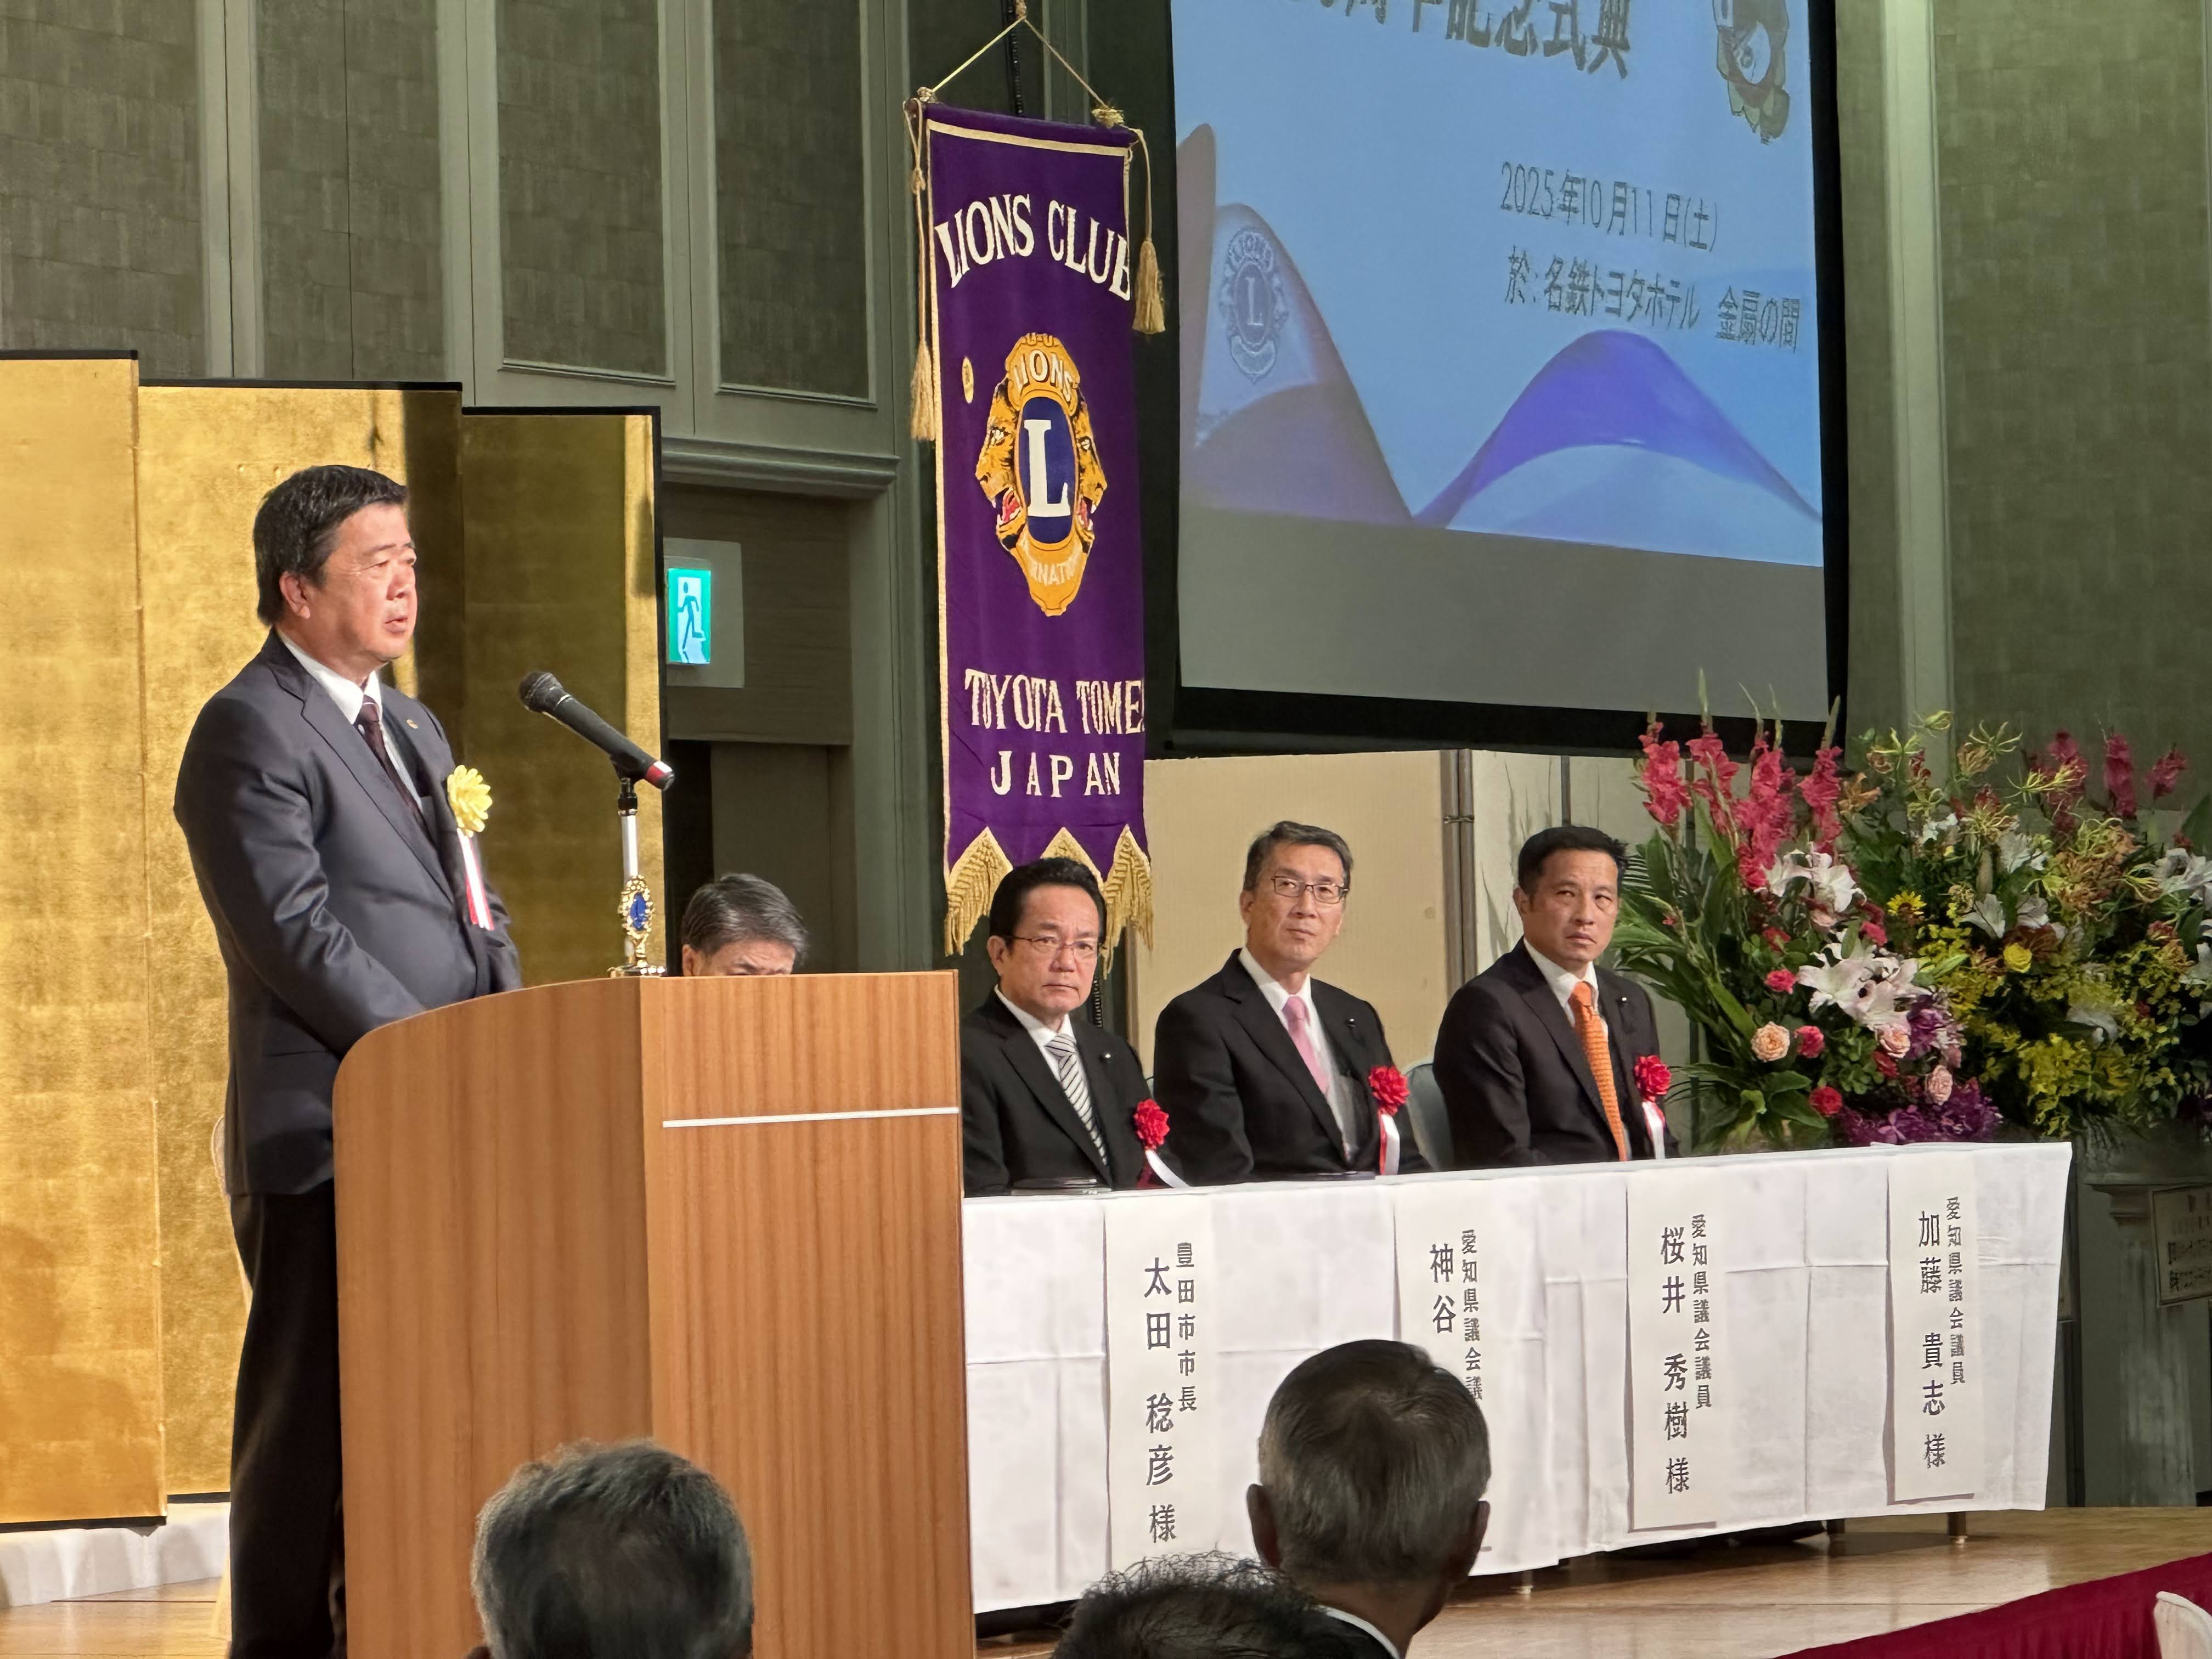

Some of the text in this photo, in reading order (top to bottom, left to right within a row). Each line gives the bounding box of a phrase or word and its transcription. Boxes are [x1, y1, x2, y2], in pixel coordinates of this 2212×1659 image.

[934, 194, 1035, 289] LIONS
[1024, 419, 1071, 517] L
[991, 751, 1120, 798] JAPAN
[1176, 1242, 1197, 1412] 豊田市市長
[1430, 1243, 1457, 1334] 神谷
[1691, 1214, 1712, 1409] 愛知県議会議員
